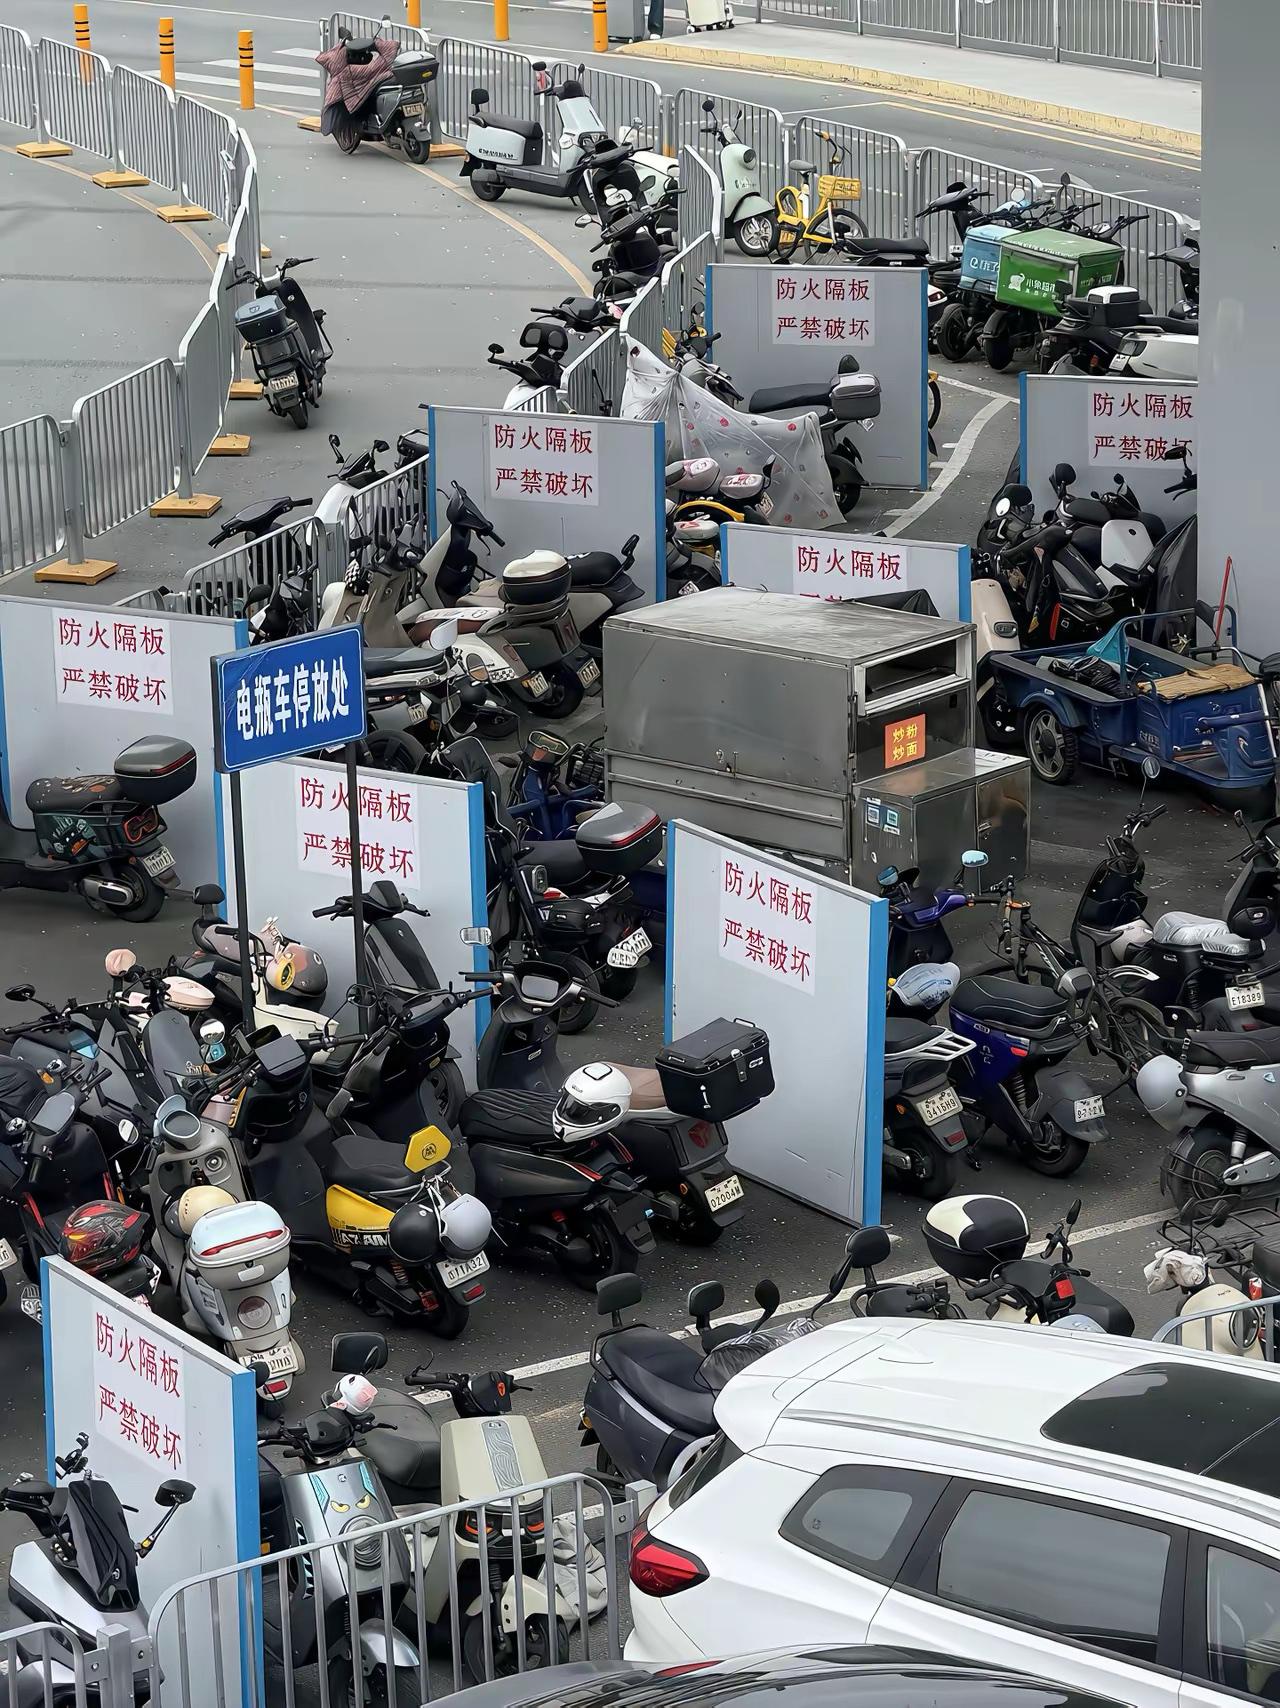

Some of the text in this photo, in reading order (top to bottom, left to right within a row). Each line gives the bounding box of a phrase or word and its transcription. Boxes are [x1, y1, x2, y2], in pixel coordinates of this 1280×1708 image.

[776, 277, 870, 301] 防火隔板
[776, 316, 870, 340] 严禁破坏
[1093, 392, 1194, 419] 防火隔板
[494, 424, 593, 454] 防火隔板
[495, 467, 593, 498] 严禁破坏
[797, 545, 902, 581] 防火隔板
[58, 617, 166, 655] 防火隔板
[62, 667, 167, 706] 严禁破坏
[236, 655, 350, 741] 电瓶车停放处
[892, 723, 918, 743] 炒粉
[892, 741, 918, 761] 炒面
[300, 777, 413, 824] 防火隔板
[303, 832, 414, 879] 严禁破坏
[724, 860, 812, 924] 防火隔板
[723, 918, 811, 982] 严禁破坏
[1231, 992, 1262, 1006] E18389
[96, 1312, 181, 1398] 防火隔板
[98, 1384, 182, 1470] 严禁破坏
